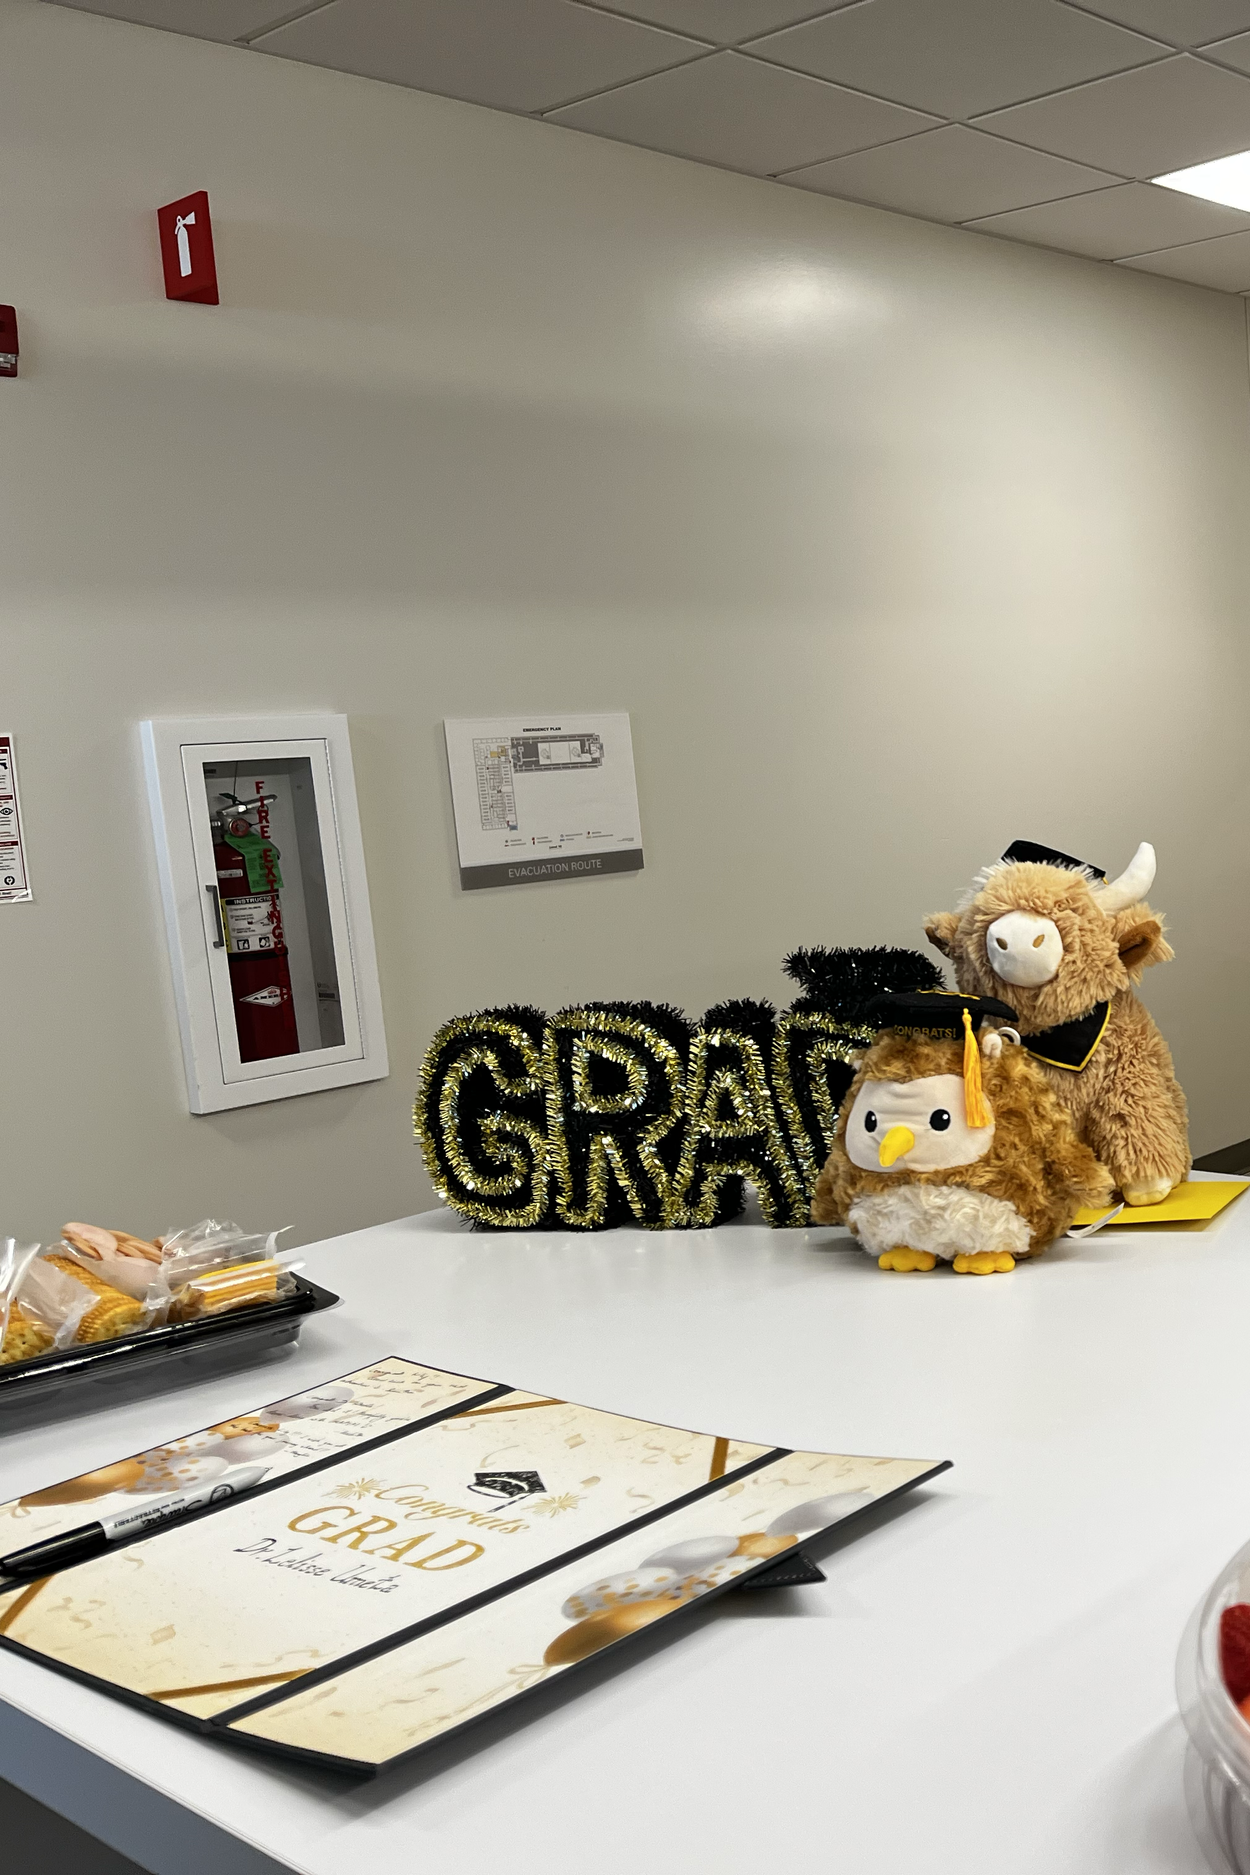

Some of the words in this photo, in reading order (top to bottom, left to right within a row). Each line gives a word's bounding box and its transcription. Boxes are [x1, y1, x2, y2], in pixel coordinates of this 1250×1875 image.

[255, 781, 272, 840] FIRE
[508, 863, 569, 878] EVACUATION
[571, 859, 602, 871] ROUTE
[233, 895, 272, 905] INSTRUCTIO
[373, 1484, 531, 1535] Congrats
[287, 1505, 487, 1572] GRAD
